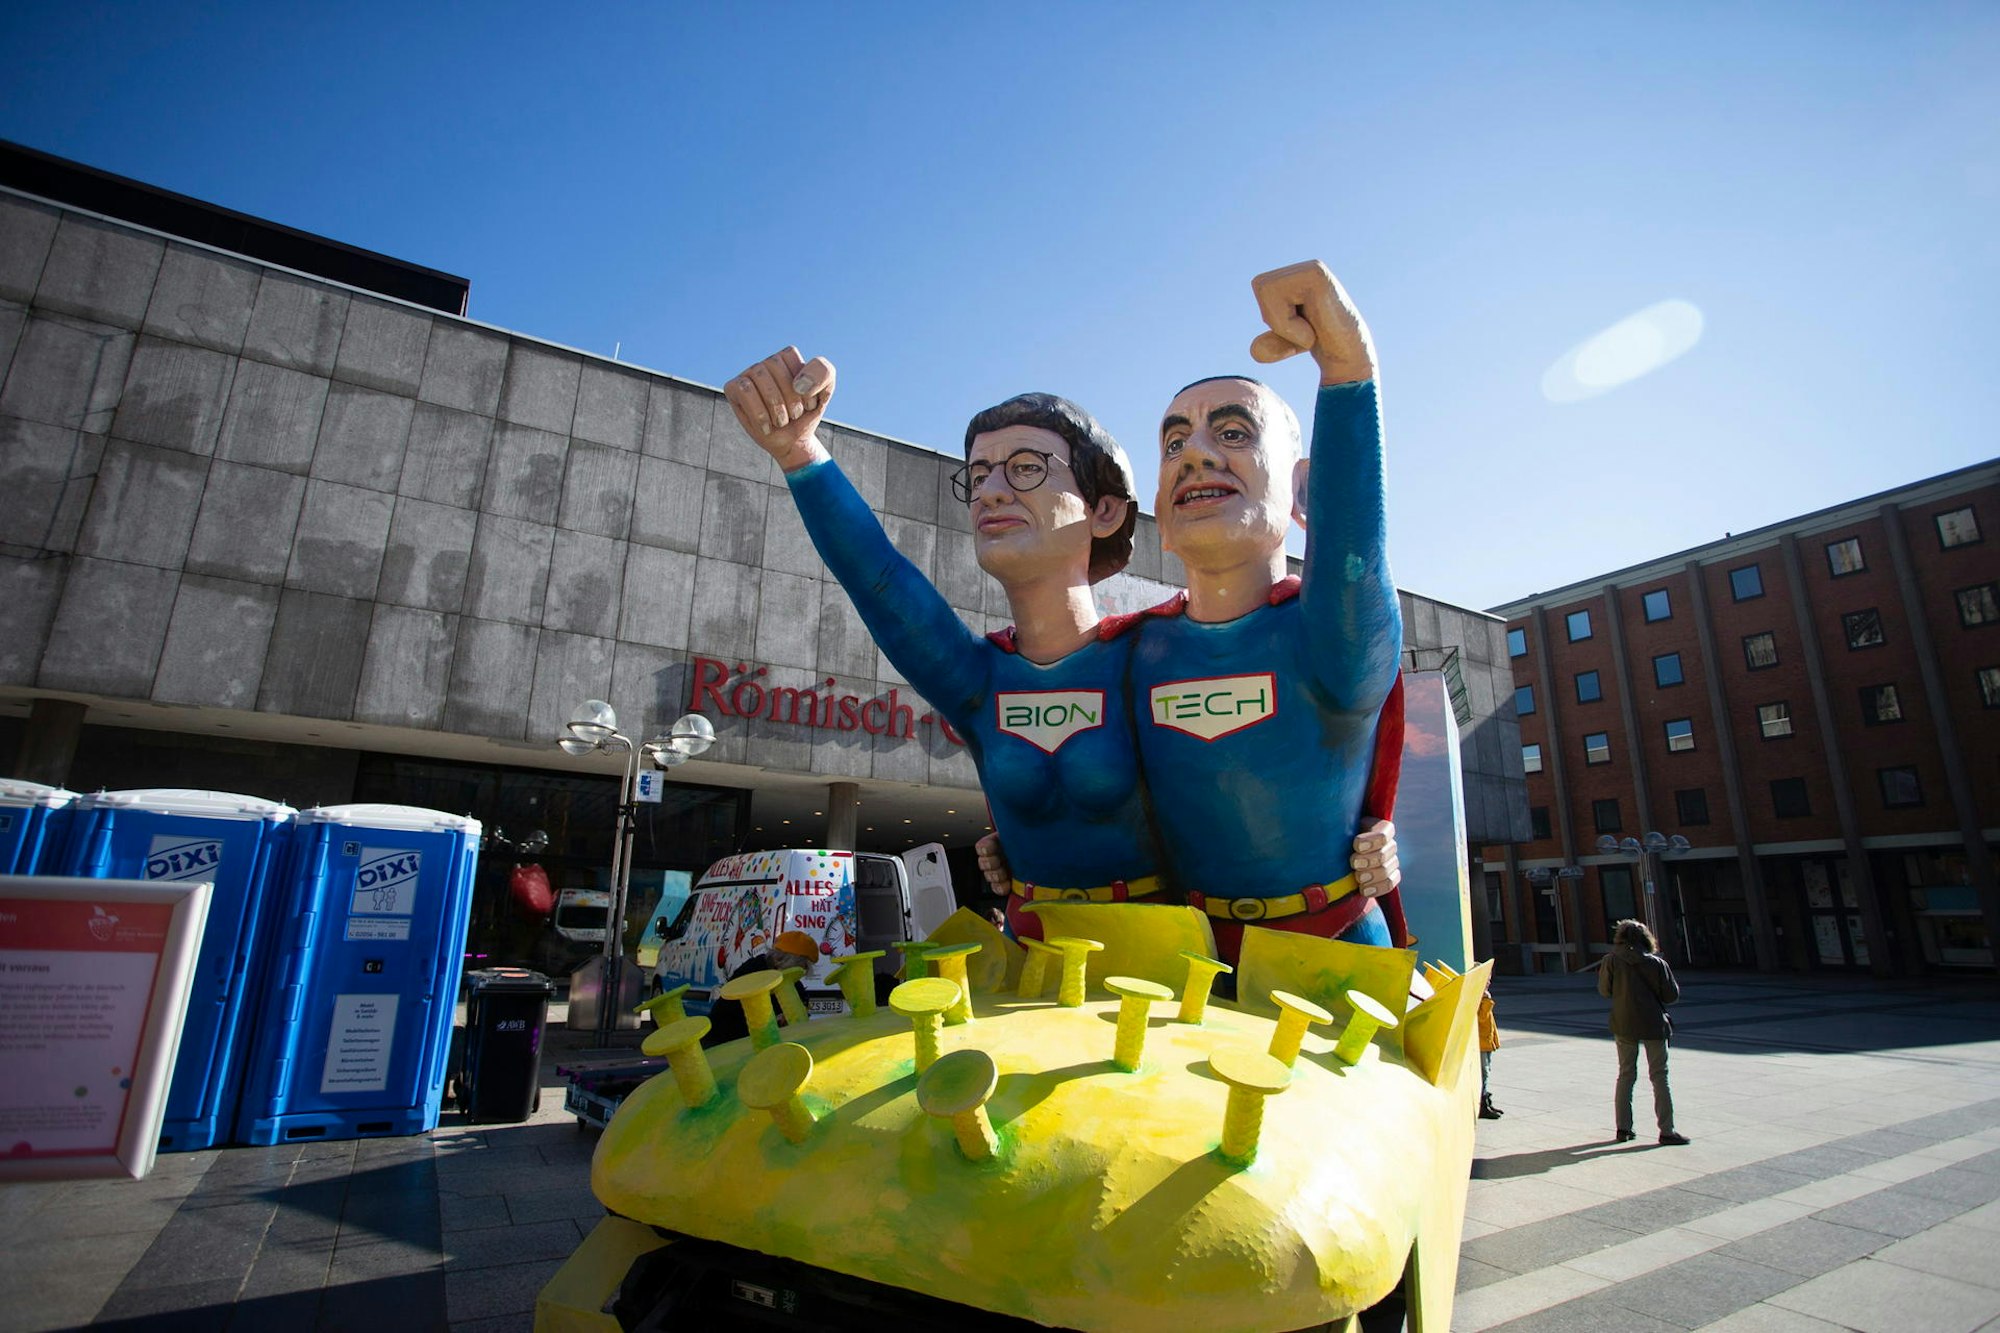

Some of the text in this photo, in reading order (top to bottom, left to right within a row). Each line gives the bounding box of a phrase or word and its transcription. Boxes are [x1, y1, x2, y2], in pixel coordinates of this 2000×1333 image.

[1155, 688, 1266, 720] TECH
[1006, 702, 1097, 728] BION
[785, 880, 835, 896] ALLES
[811, 897, 833, 912] HÄT
[794, 915, 826, 929] SING
[507, 1020, 525, 1028] AWB
